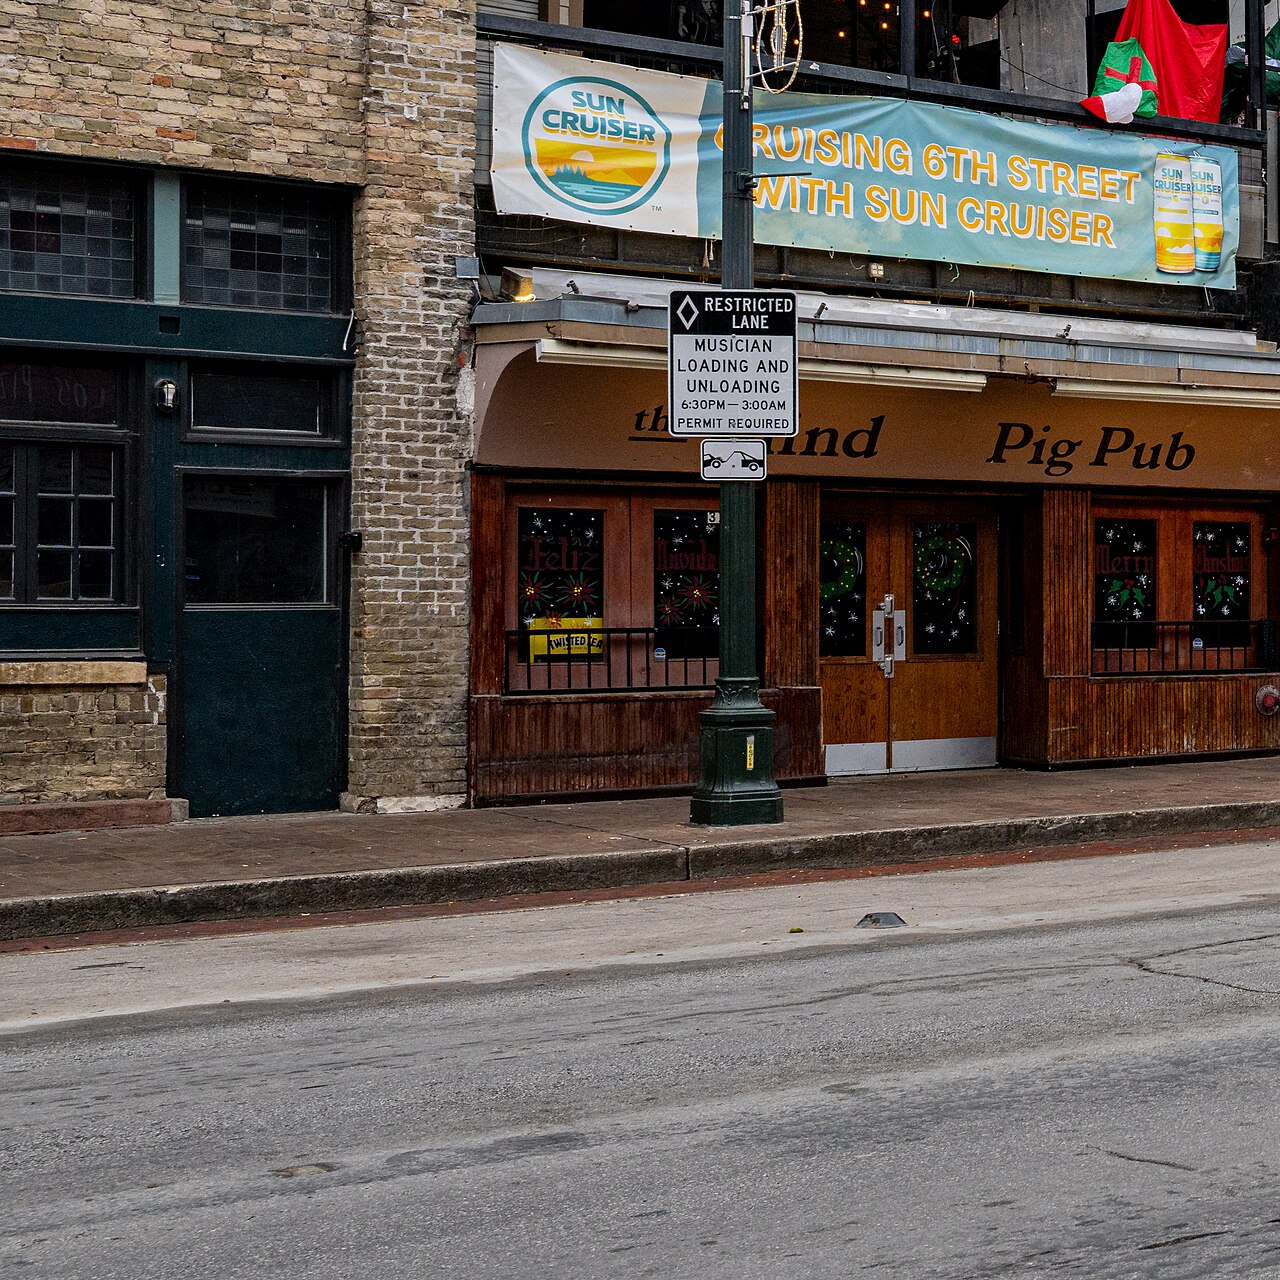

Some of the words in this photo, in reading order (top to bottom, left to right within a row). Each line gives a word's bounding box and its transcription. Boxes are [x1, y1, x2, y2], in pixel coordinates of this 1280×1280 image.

[571, 89, 626, 118] SUN
[542, 109, 656, 144] CRUISER
[923, 143, 997, 185] 6TH
[1008, 155, 1141, 203] STREET
[1162, 167, 1183, 180] SUN
[1192, 171, 1214, 183] SUN
[753, 173, 854, 218] WITH
[864, 185, 947, 228] SUN
[957, 197, 1117, 248] CRUISER
[704, 297, 793, 313] RESTRICTED
[732, 315, 769, 329] LANE
[694, 338, 772, 352] MUSICIAN
[677, 359, 748, 372] LOADING
[756, 360, 789, 373] AND
[687, 379, 780, 393] UNLOADING
[677, 418, 723, 428] PERMIT
[729, 418, 789, 429] REQUIRED
[634, 405, 668, 433] th
[985, 422, 1083, 477] Pig
[1088, 426, 1196, 470] Pub
